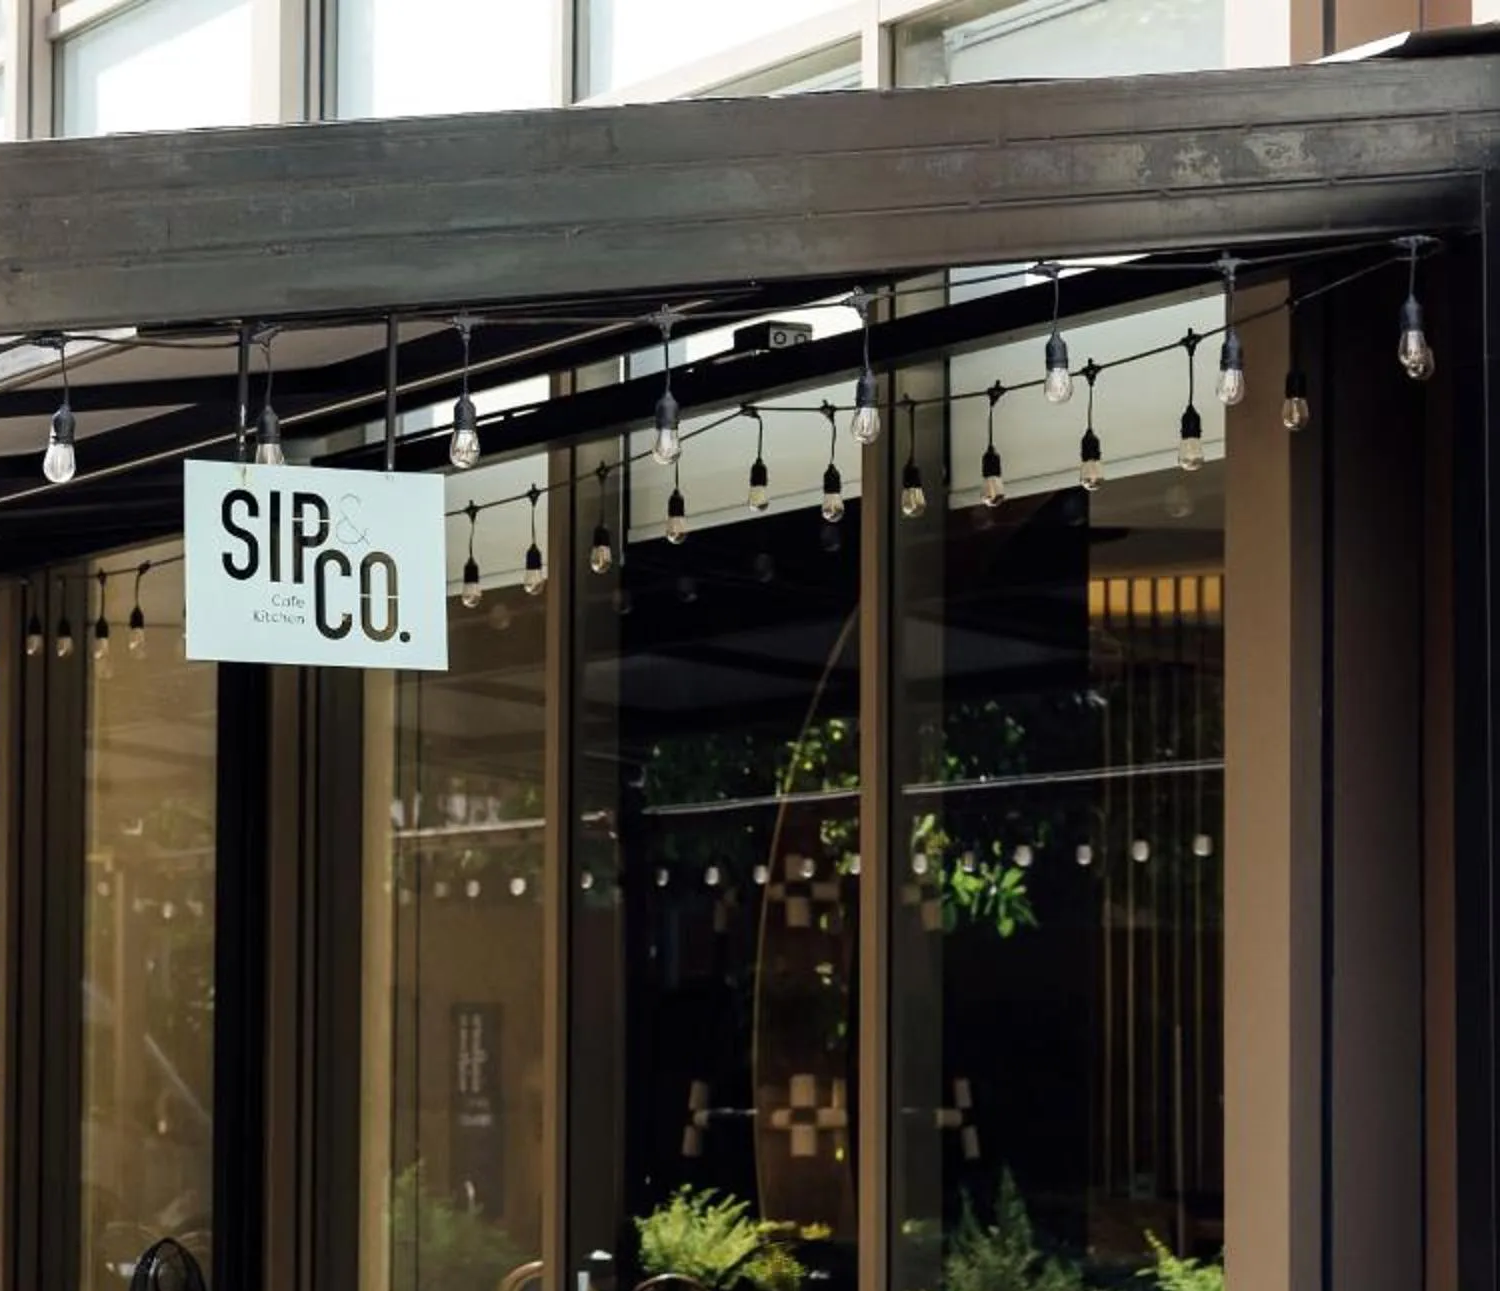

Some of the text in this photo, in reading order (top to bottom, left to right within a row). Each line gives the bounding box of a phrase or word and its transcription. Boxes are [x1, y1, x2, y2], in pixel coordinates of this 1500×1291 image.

[221, 489, 330, 584] SIP
[253, 609, 306, 625] Kitchen
[314, 549, 411, 643] CO.
